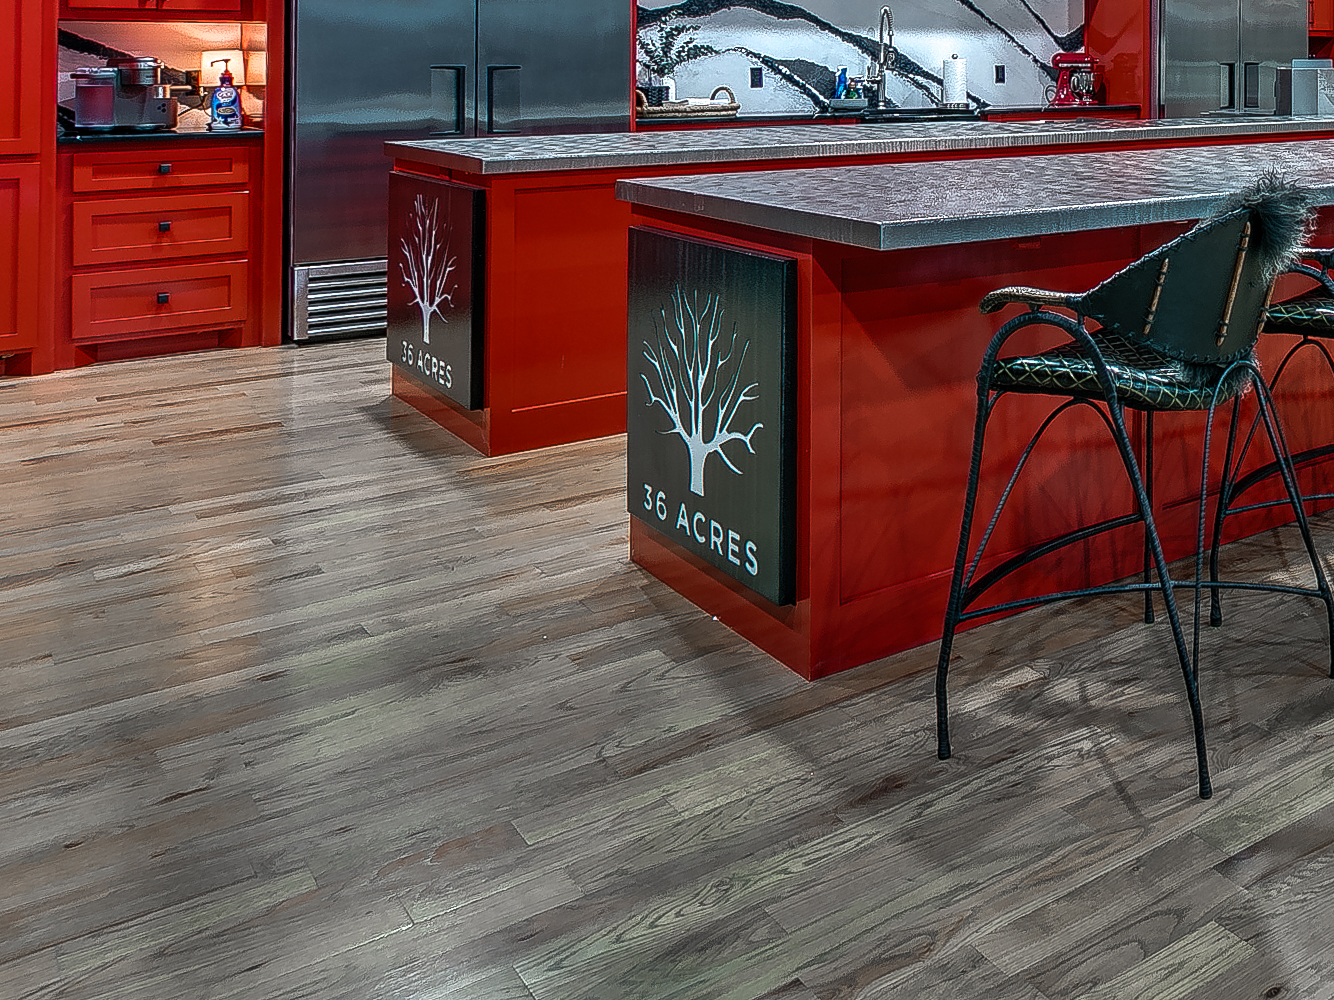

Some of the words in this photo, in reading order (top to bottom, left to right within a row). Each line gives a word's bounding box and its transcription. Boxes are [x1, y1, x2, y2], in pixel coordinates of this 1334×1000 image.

[402, 340, 414, 366] 36
[416, 349, 452, 389] ACRES
[643, 483, 667, 521] 36
[676, 502, 758, 576] ACRES
